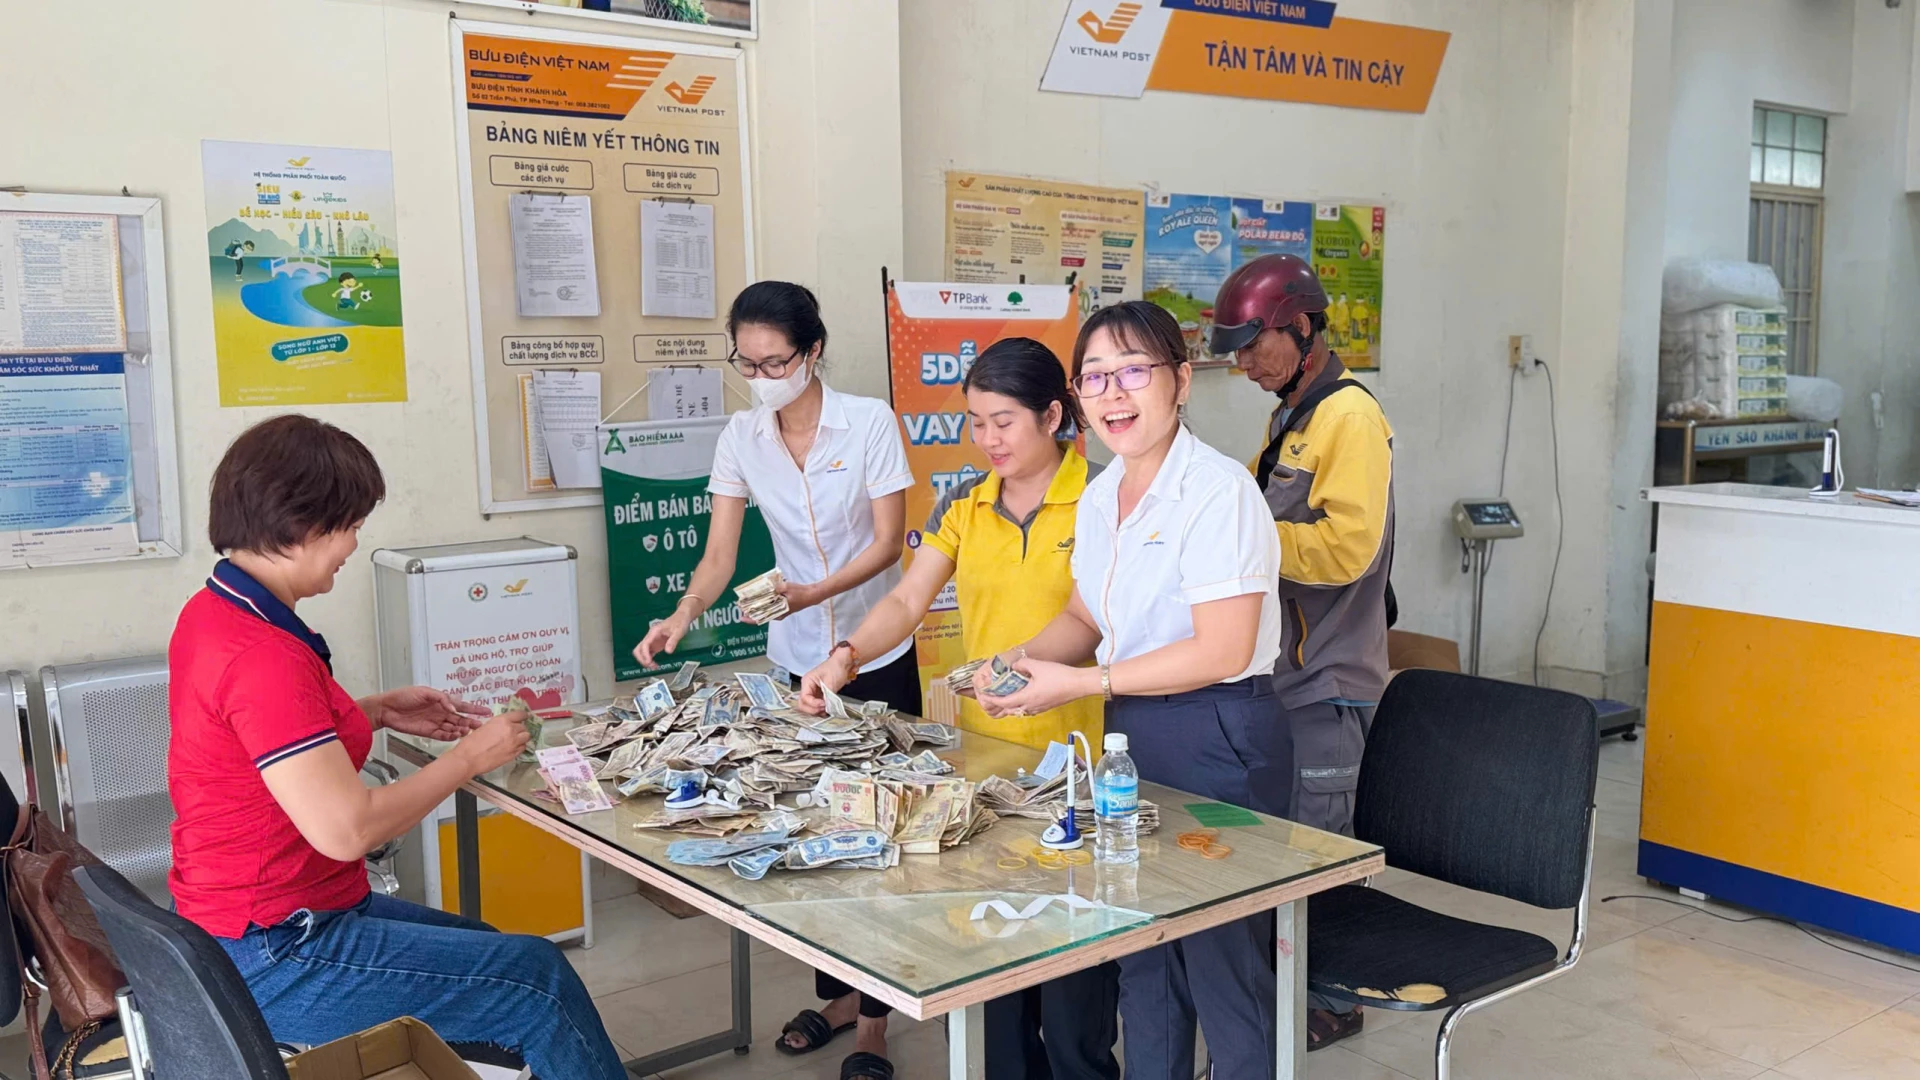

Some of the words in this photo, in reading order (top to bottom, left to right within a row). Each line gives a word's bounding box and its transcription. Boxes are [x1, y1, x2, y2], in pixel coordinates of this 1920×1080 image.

[1253, 1, 1277, 17] VIỆT
[1280, 4, 1306, 19] NAM
[469, 49, 501, 62] BƯU
[503, 52, 540, 69] ĐIỆN
[543, 55, 575, 71] VIỆT
[578, 60, 610, 72] NAM
[1069, 46, 1118, 58] VIETNAM
[1122, 51, 1151, 62] POST
[1204, 40, 1247, 72] TẬN
[1253, 45, 1296, 75] TÂM
[1302, 51, 1327, 78] VÀ
[1332, 57, 1363, 82] TIN
[1368, 59, 1404, 88] CẬY
[657, 105, 699, 115] VIETNAM
[701, 108, 726, 117] POST
[486, 120, 538, 145] BẢNG
[543, 127, 587, 148] NIÊM
[592, 128, 626, 150] YẾT
[630, 133, 690, 154] THÔNG
[694, 140, 720, 156] TIN
[537, 163, 549, 173] giá
[667, 170, 678, 179] giá
[520, 174, 534, 182] các
[536, 174, 553, 184] dịch
[555, 176, 565, 184] vụ
[652, 181, 665, 189] các
[666, 181, 681, 190] dịch
[953, 292, 989, 304] TPBank
[656, 338, 672, 347] Các
[673, 339, 685, 347] nội
[686, 339, 705, 348] dung
[550, 351, 567, 360] dịch
[568, 352, 578, 360] vụ
[902, 413, 966, 444] VAY
[614, 492, 654, 525] ĐIỂM
[658, 493, 689, 520] BÁN
[693, 487, 713, 516] BẢ
[663, 527, 675, 551] Ô
[677, 524, 698, 549] TÔ
[666, 572, 686, 593] XE
[704, 601, 742, 629] NGƯỜ
[463, 636, 496, 649] TRỌNG
[522, 631, 537, 640] ƠN
[730, 648, 747, 657] 1900
